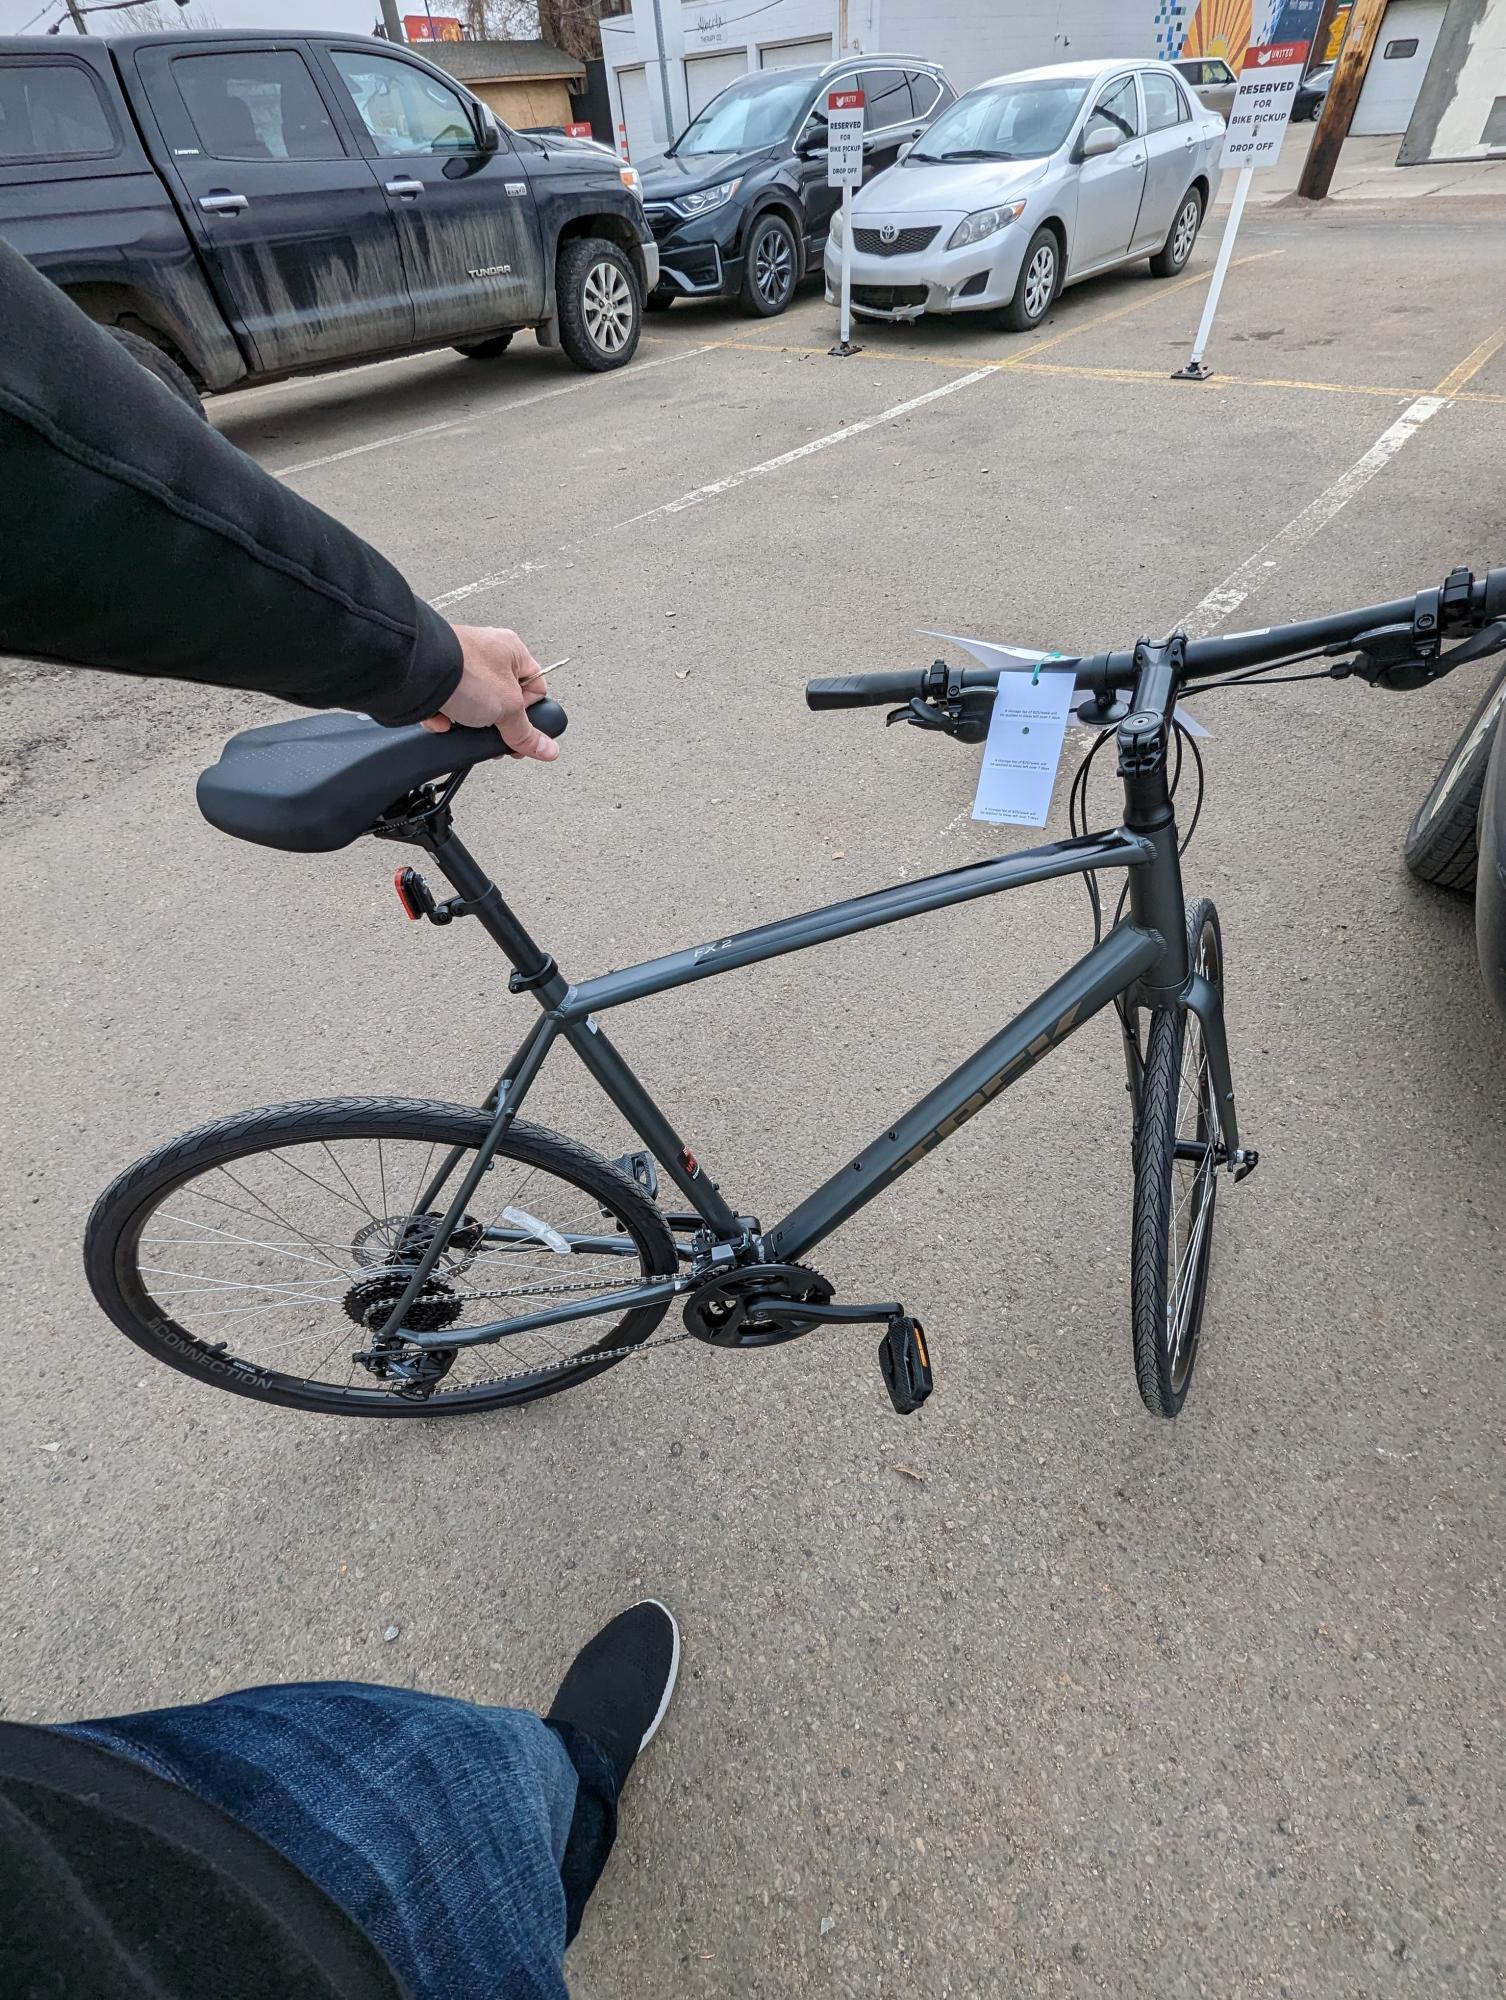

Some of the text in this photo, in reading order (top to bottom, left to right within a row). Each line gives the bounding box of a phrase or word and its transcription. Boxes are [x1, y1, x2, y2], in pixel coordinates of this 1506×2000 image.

[1271, 48, 1294, 59] UNITED
[1239, 81, 1295, 95] RESERVED
[1253, 99, 1272, 109] FOR
[1231, 112, 1287, 125] BIKE PICKUP
[830, 121, 862, 130] RESERVED
[842, 145, 861, 153] PICKUP
[1229, 142, 1274, 153] DROP OFF
[847, 167, 858, 175] OFF
[468, 264, 511, 278] TUNDRA
[694, 939, 732, 957] FX 2
[891, 1002, 1083, 1172] TREK
[153, 1323, 273, 1390] CONNECTION
